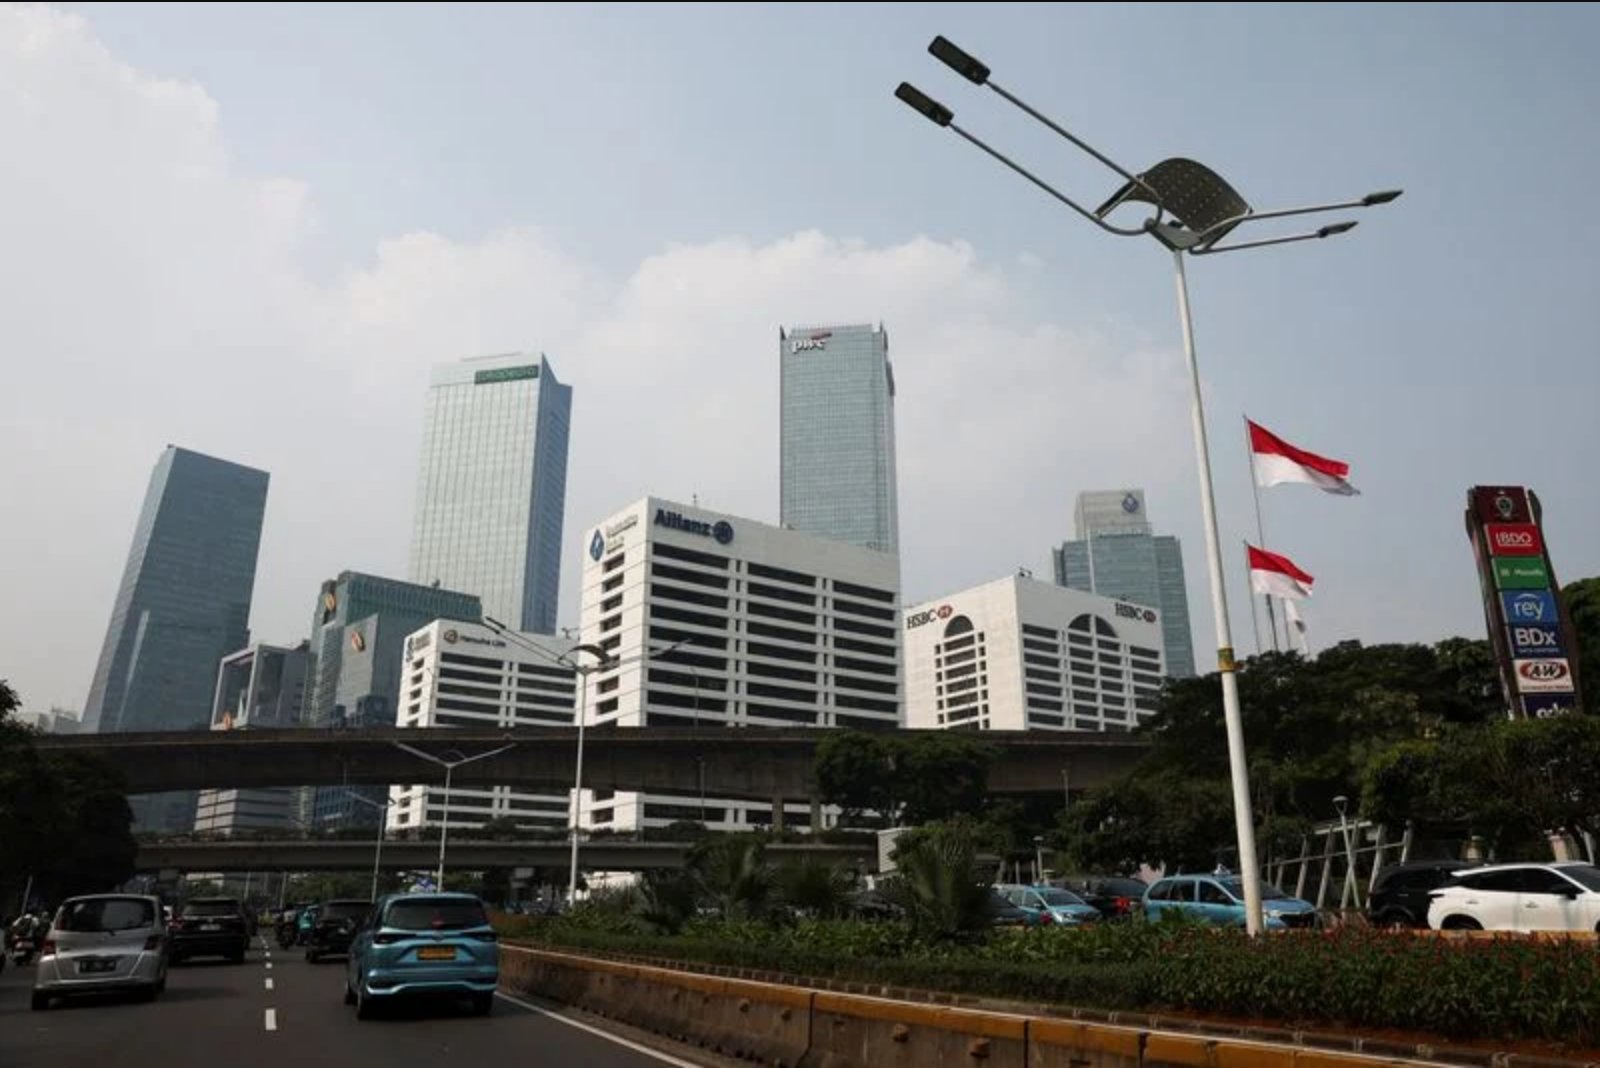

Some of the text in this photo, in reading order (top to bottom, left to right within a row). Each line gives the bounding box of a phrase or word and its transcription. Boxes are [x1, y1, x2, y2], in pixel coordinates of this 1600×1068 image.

[654, 510, 711, 537] Allianz
[907, 609, 937, 630] HSBC
[1115, 602, 1142, 620] HSBC
[1514, 602, 1544, 620] rey
[1515, 628, 1556, 645] BDx
